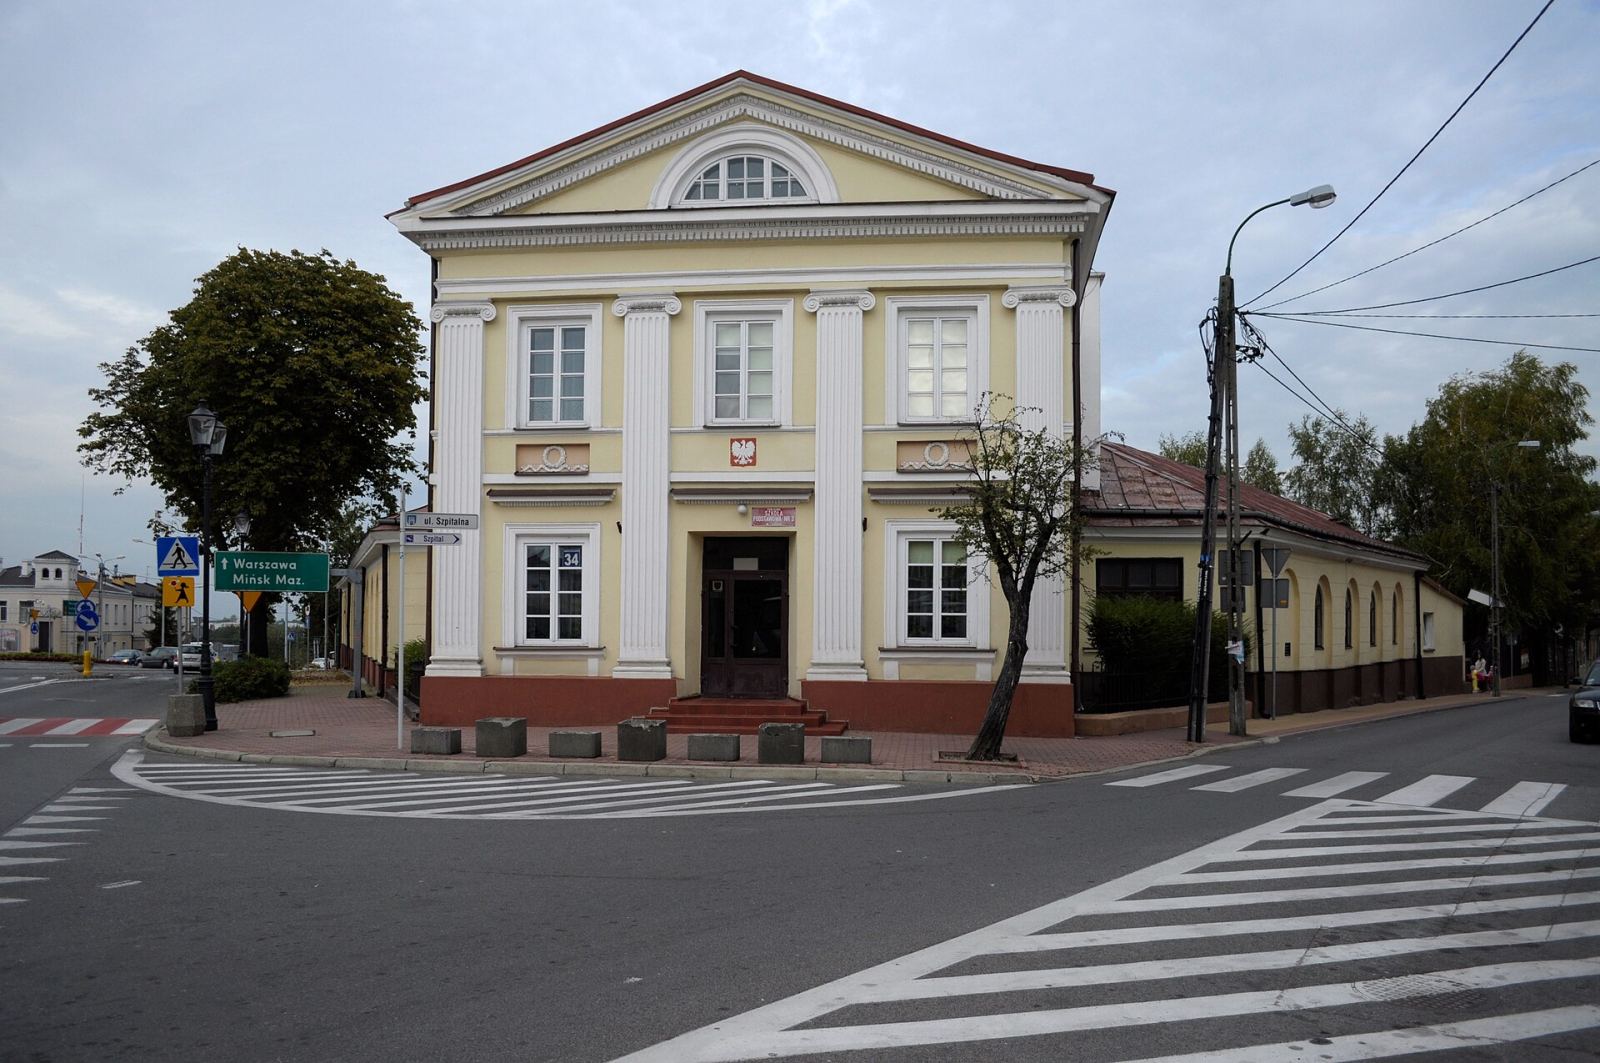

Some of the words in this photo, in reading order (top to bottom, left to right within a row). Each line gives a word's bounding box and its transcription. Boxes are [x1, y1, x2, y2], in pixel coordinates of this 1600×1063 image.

[424, 517, 434, 525] ul.
[436, 517, 469, 526] Szpitalna
[423, 535, 444, 543] Szpital
[233, 558, 297, 570] Warszawa
[564, 553, 579, 566] 34
[233, 574, 270, 585] Mińsk
[276, 574, 305, 585] Maz.
